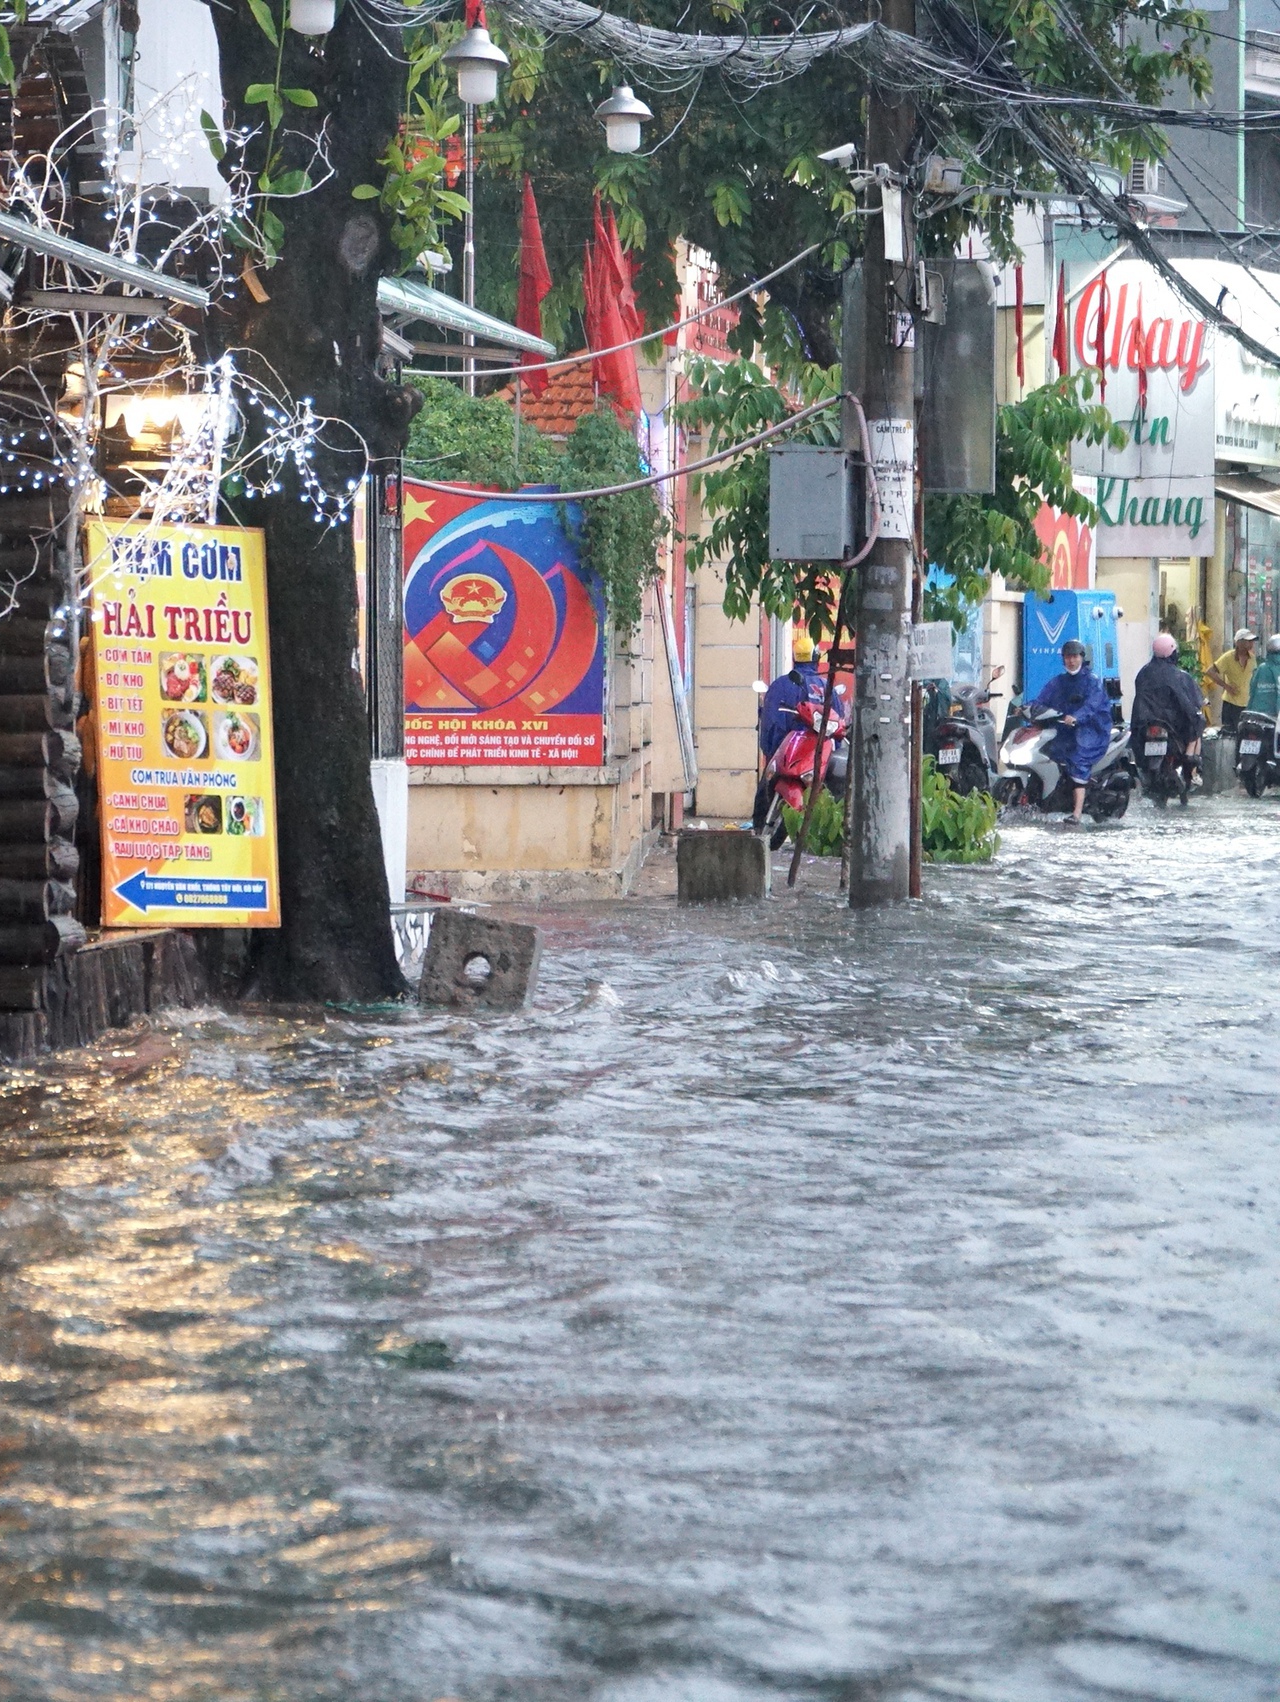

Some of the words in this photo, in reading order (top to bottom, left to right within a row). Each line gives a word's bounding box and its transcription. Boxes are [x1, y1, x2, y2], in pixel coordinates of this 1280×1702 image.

[1074, 279, 1210, 392] Chay
[1096, 476, 1208, 539] Khang
[182, 539, 242, 581] CƠM
[102, 588, 156, 638] HẢI
[164, 592, 252, 644] TRIỀU
[1032, 647, 1062, 655] VINFA
[404, 717, 433, 730] UỐC
[438, 718, 467, 732] HỘI
[472, 718, 517, 730] KHÓA
[521, 720, 548, 731] XVI
[404, 735, 416, 745] NG
[479, 733, 502, 745] SÁNG
[503, 735, 519, 747] TẠO
[521, 734, 532, 745] VÀ
[584, 733, 595, 746] SỐ
[406, 748, 418, 759] ỰC
[461, 747, 482, 758] PHÁT
[509, 749, 529, 758] KINH
[548, 747, 560, 758] XÃ
[113, 793, 138, 805] CANH
